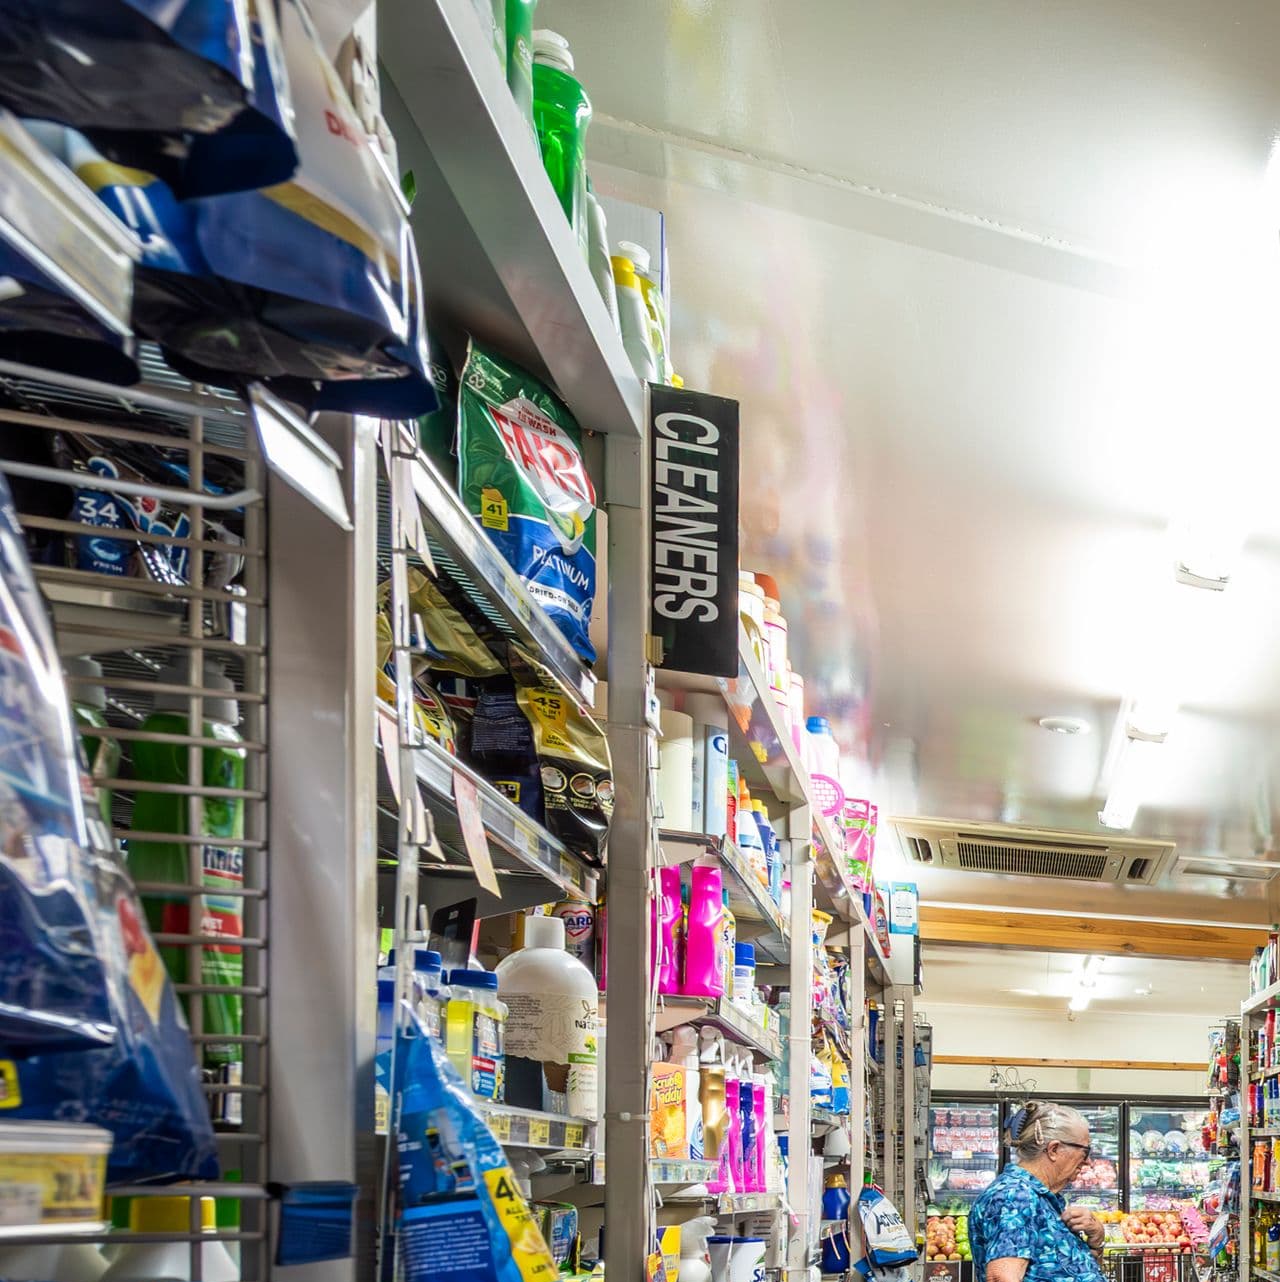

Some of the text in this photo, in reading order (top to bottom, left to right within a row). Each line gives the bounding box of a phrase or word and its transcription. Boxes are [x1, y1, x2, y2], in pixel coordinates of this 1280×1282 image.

[486, 503, 503, 516] 41
[654, 411, 720, 624] CLEANERS
[532, 545, 589, 591] PLATINUM
